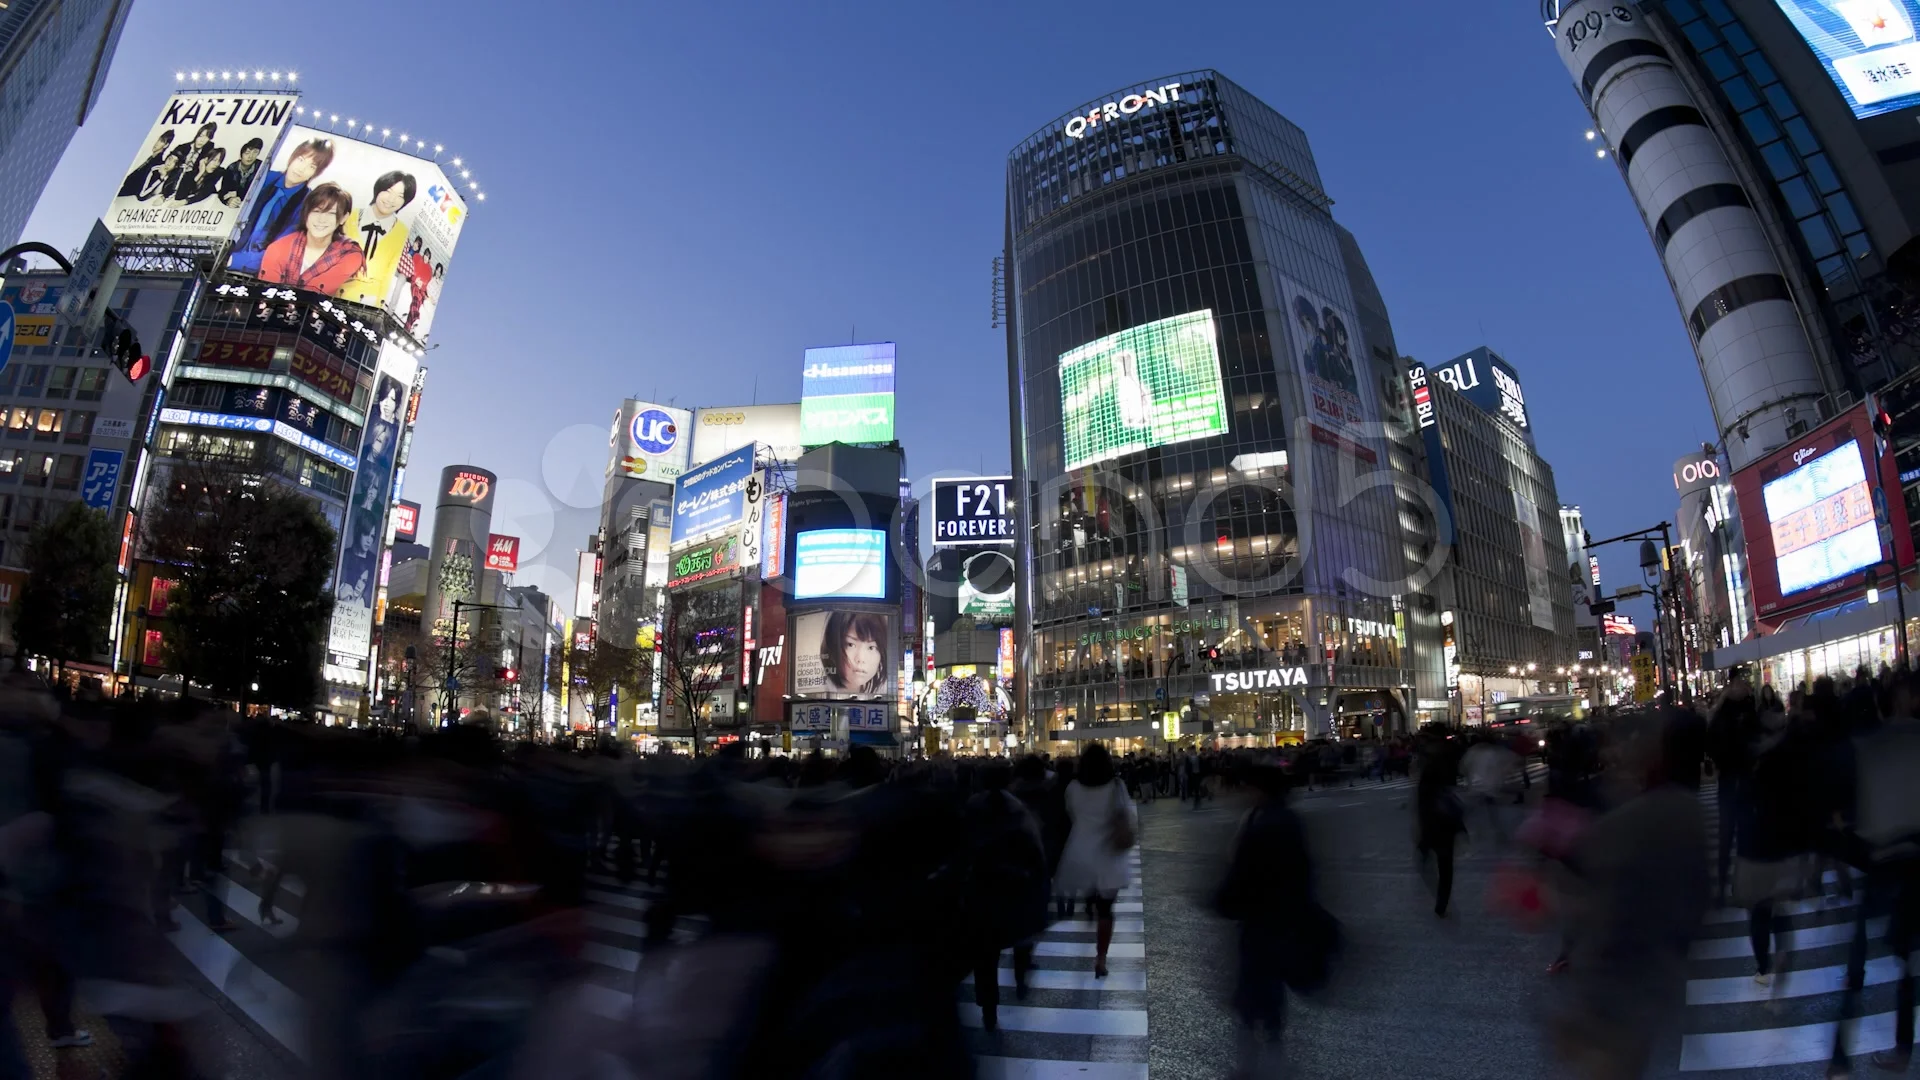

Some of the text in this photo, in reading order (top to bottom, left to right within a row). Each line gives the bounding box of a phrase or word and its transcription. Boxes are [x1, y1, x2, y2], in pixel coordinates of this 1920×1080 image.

[161, 99, 293, 126] KAT-TUN
[1065, 82, 1181, 139] QFRONT
[117, 208, 224, 225] CHANGE UR WORLD
[201, 341, 272, 363] プライス
[292, 352, 351, 396] コンタクト
[804, 363, 893, 378] Hisamitsu
[1409, 367, 1435, 428] SEIBU
[163, 409, 187, 422] AEON
[190, 414, 254, 430] 英会話イーオン
[636, 417, 674, 445] UC
[276, 424, 356, 467] AEON 英会話イーオン
[1793, 447, 1816, 465] Glico
[459, 472, 489, 482] SHIBUYA
[661, 468, 681, 476] VISA
[449, 477, 489, 503] 109
[957, 483, 1006, 516] F21
[742, 476, 762, 560] もんじゃ
[937, 519, 1007, 537] FOREVER
[1777, 486, 1870, 549] 三千里薬品
[493, 538, 513, 553] H&M
[1589, 556, 1600, 585] SEIBU
[1081, 616, 1229, 646] STARBUCKS COFFEE
[797, 667, 813, 676] close
[820, 666, 836, 677] you
[1211, 667, 1308, 691] TSUTAYA
